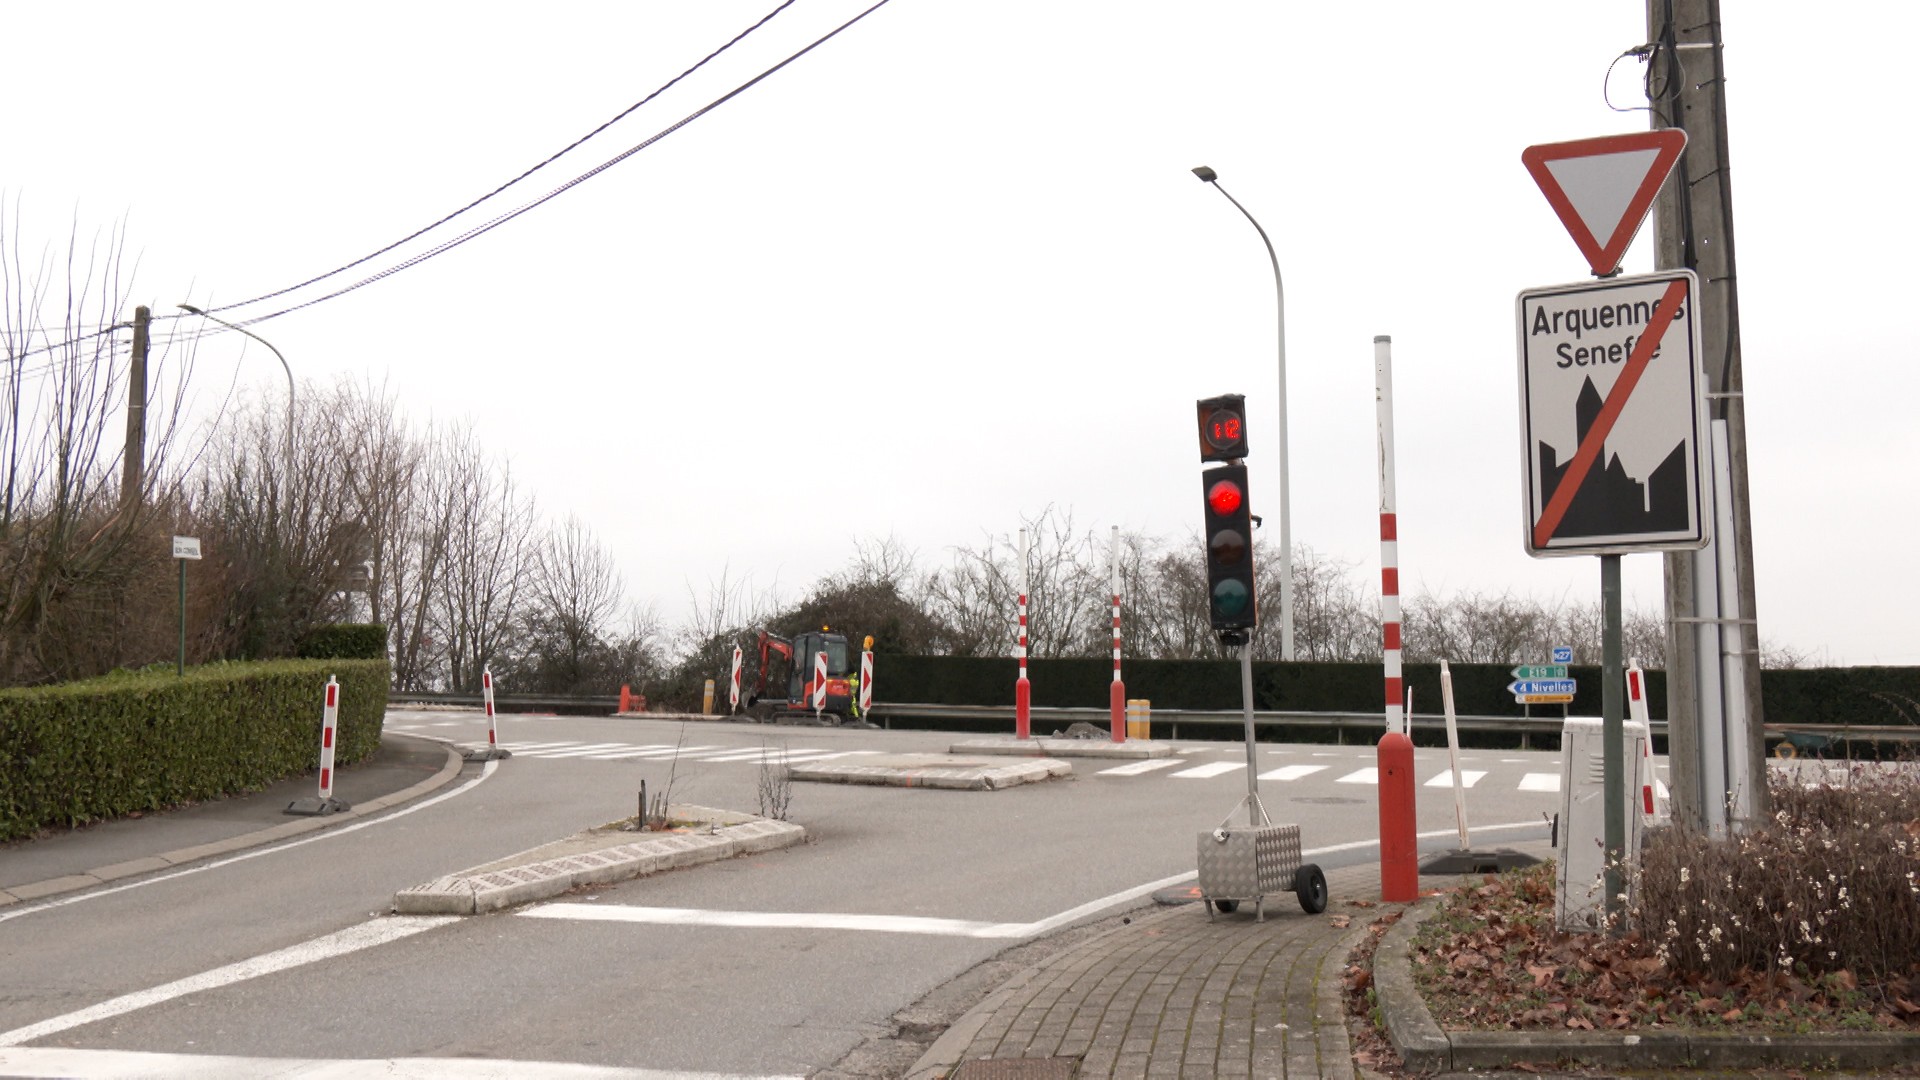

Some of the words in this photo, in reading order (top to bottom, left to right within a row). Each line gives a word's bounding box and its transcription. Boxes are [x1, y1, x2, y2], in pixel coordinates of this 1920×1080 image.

[1556, 335, 1661, 369] Senef
[1554, 651, 1570, 660] N27
[1529, 667, 1547, 678] E19
[1532, 681, 1573, 692] Nivelles
